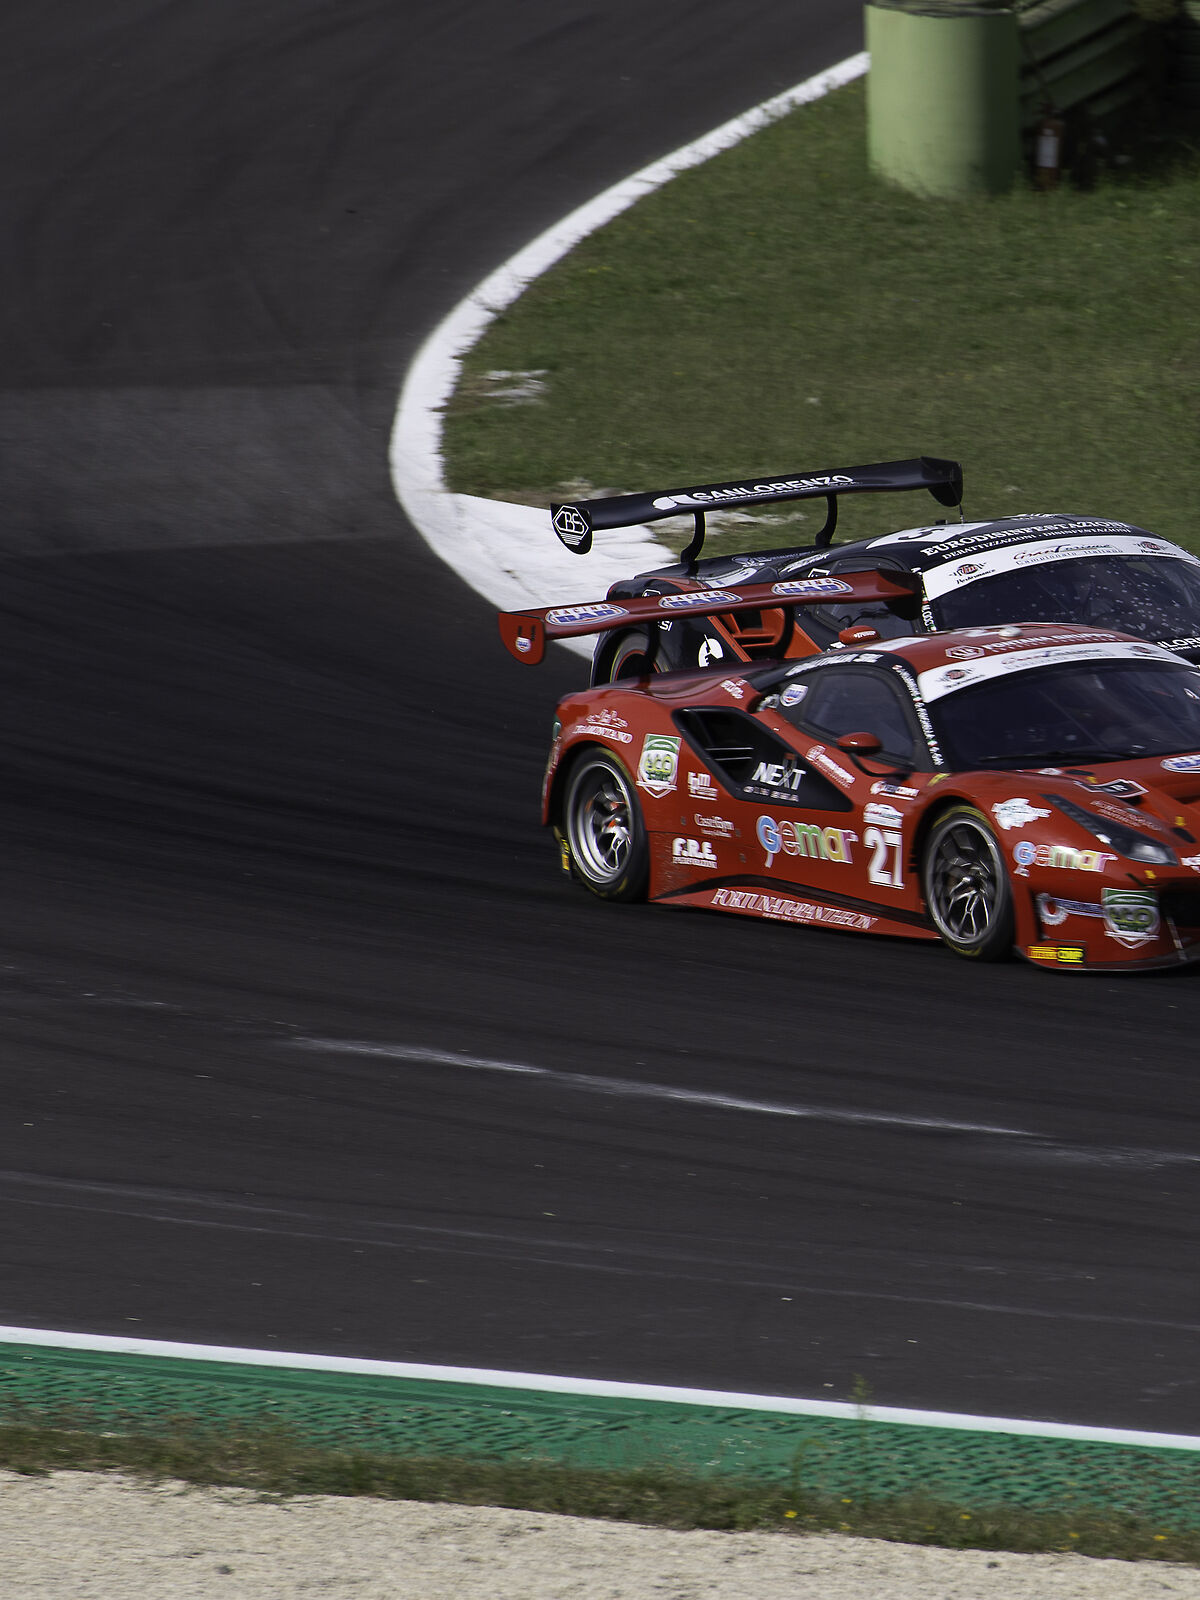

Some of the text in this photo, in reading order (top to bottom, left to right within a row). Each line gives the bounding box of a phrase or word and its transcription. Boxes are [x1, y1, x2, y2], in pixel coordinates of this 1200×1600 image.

[692, 475, 854, 501] SANLORENZO
[920, 520, 1131, 557] EURODISINFESTAZIONI
[751, 761, 808, 791] NEXT
[863, 826, 906, 890] 27
